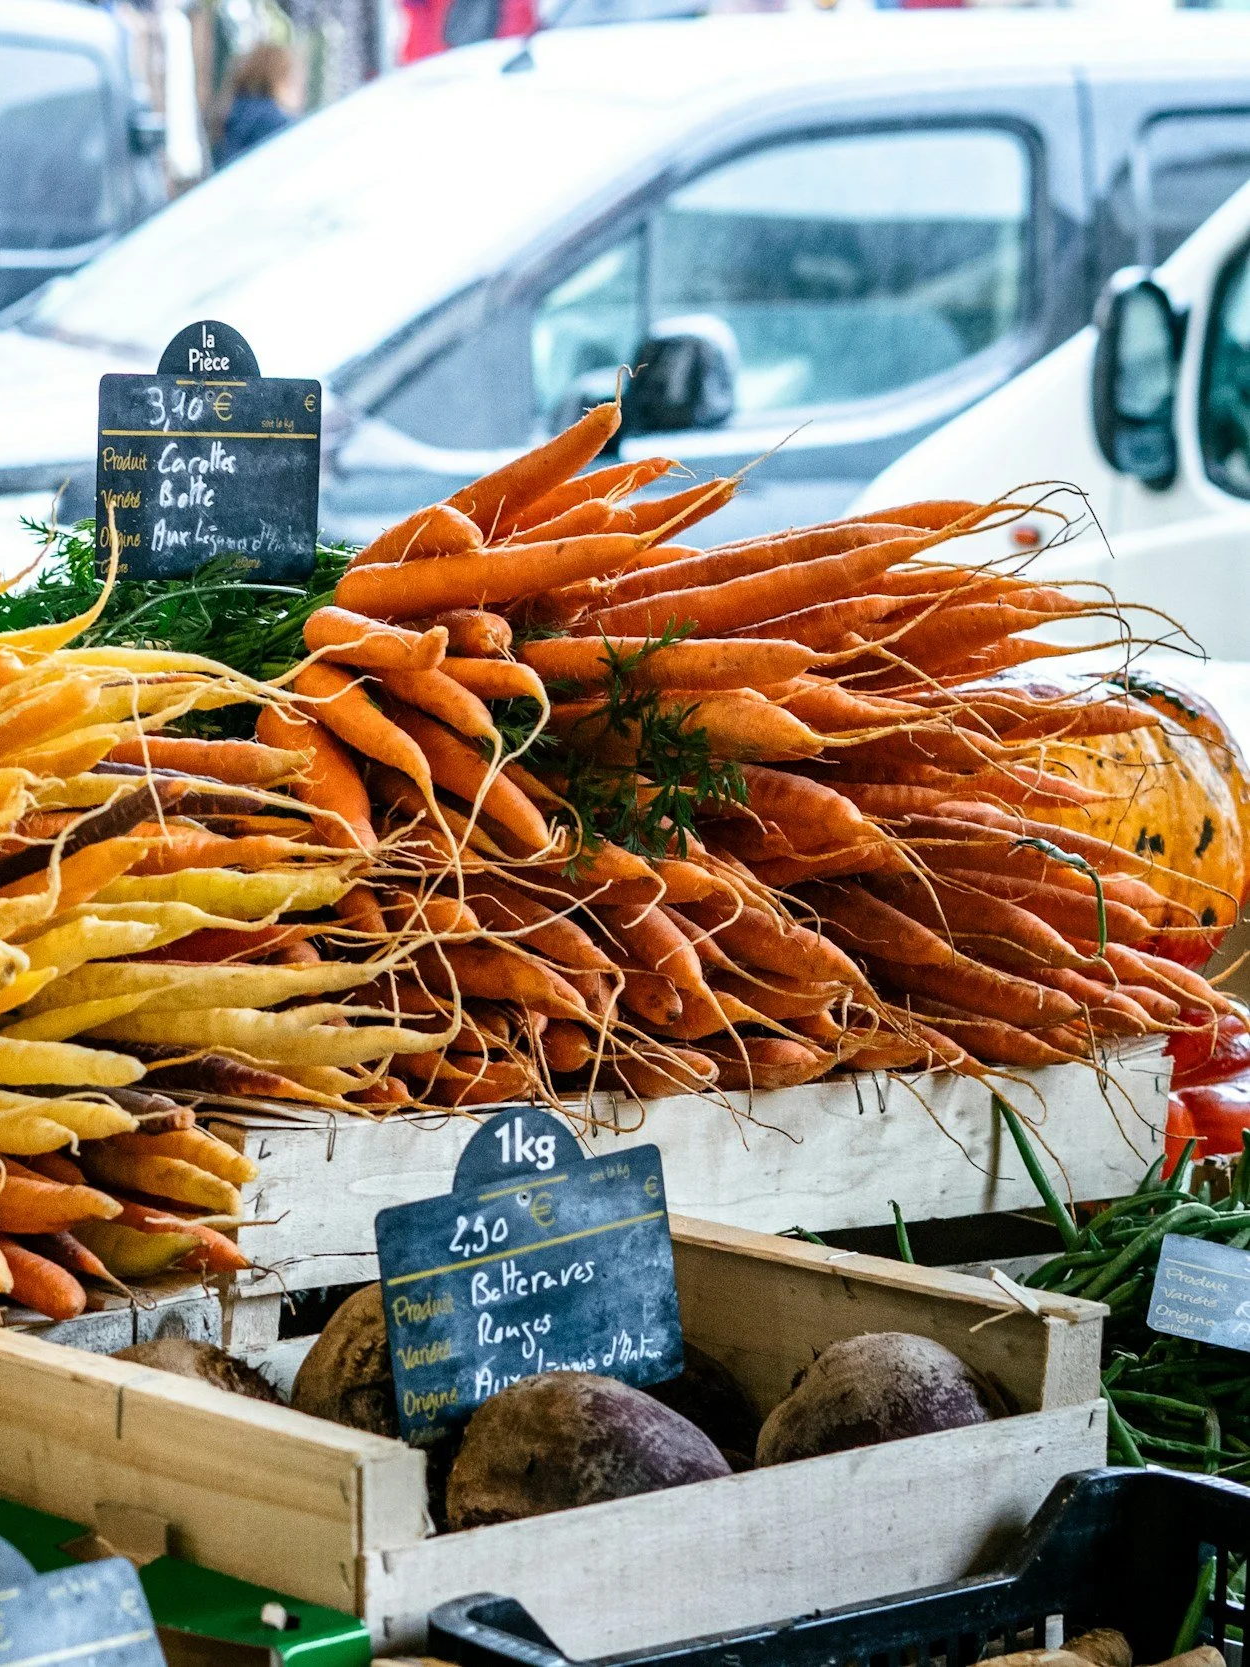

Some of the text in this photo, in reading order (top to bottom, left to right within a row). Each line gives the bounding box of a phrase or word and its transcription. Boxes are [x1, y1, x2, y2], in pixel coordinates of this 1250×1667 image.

[202, 325, 215, 348] la
[189, 348, 230, 372] Pièce
[147, 387, 233, 432] 3,10 €
[304, 394, 316, 412] €
[103, 441, 236, 474] Produit Carottes
[101, 475, 215, 509] Variété Botte
[151, 518, 191, 550] Aux
[495, 1117, 556, 1171] 1kg
[643, 1175, 661, 1198] €
[530, 1191, 555, 1227] €
[1165, 1267, 1228, 1292] Produit
[392, 1291, 454, 1328] Produit
[1160, 1286, 1218, 1308] Variété
[1155, 1304, 1215, 1326] Origine
[478, 1312, 552, 1359] Rouges
[403, 1387, 457, 1420] Origine
